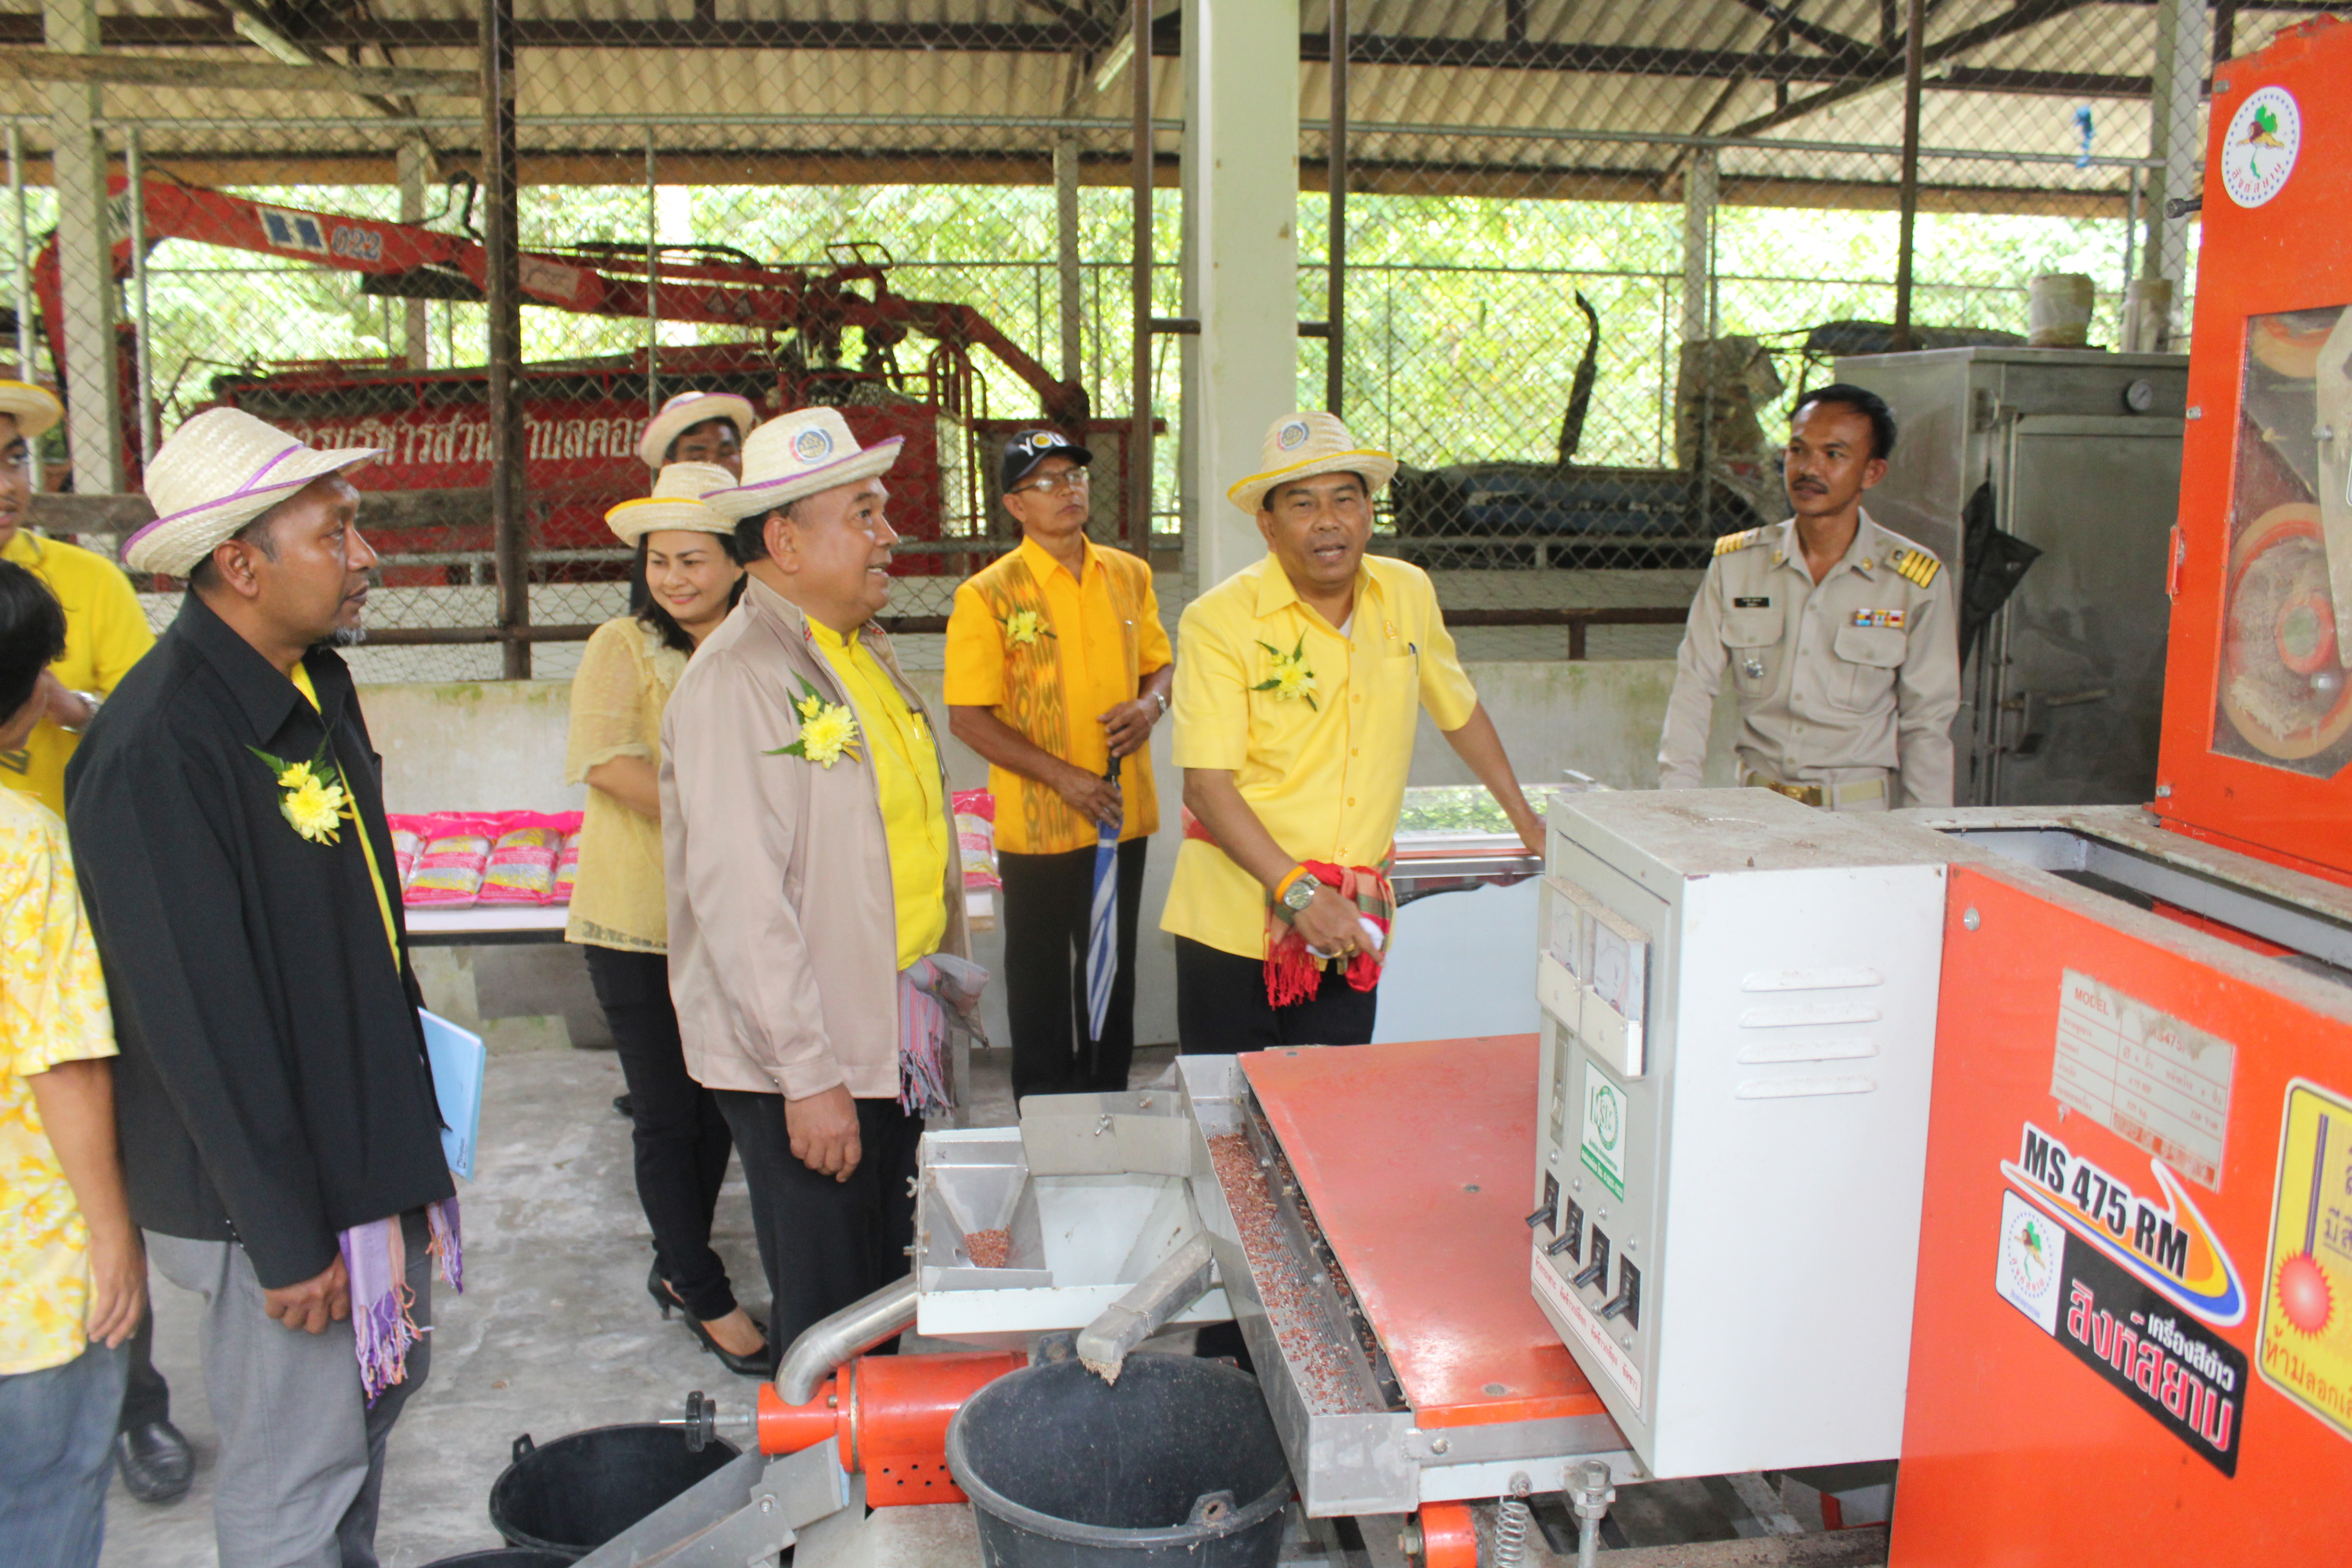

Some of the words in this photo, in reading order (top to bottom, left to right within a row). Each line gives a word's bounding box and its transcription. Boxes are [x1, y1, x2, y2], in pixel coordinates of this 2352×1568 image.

[332, 225, 382, 262] 022
[1019, 433, 1066, 456] YOU
[2074, 987, 2109, 1016] MODEL
[2024, 1129, 2066, 1194] MS
[2072, 1165, 2127, 1237] 475
[2133, 1203, 2189, 1282] RM
[2067, 1277, 2234, 1452] สิงห์สยาม
[2147, 1313, 2236, 1392] เครื่องสีข้าว
